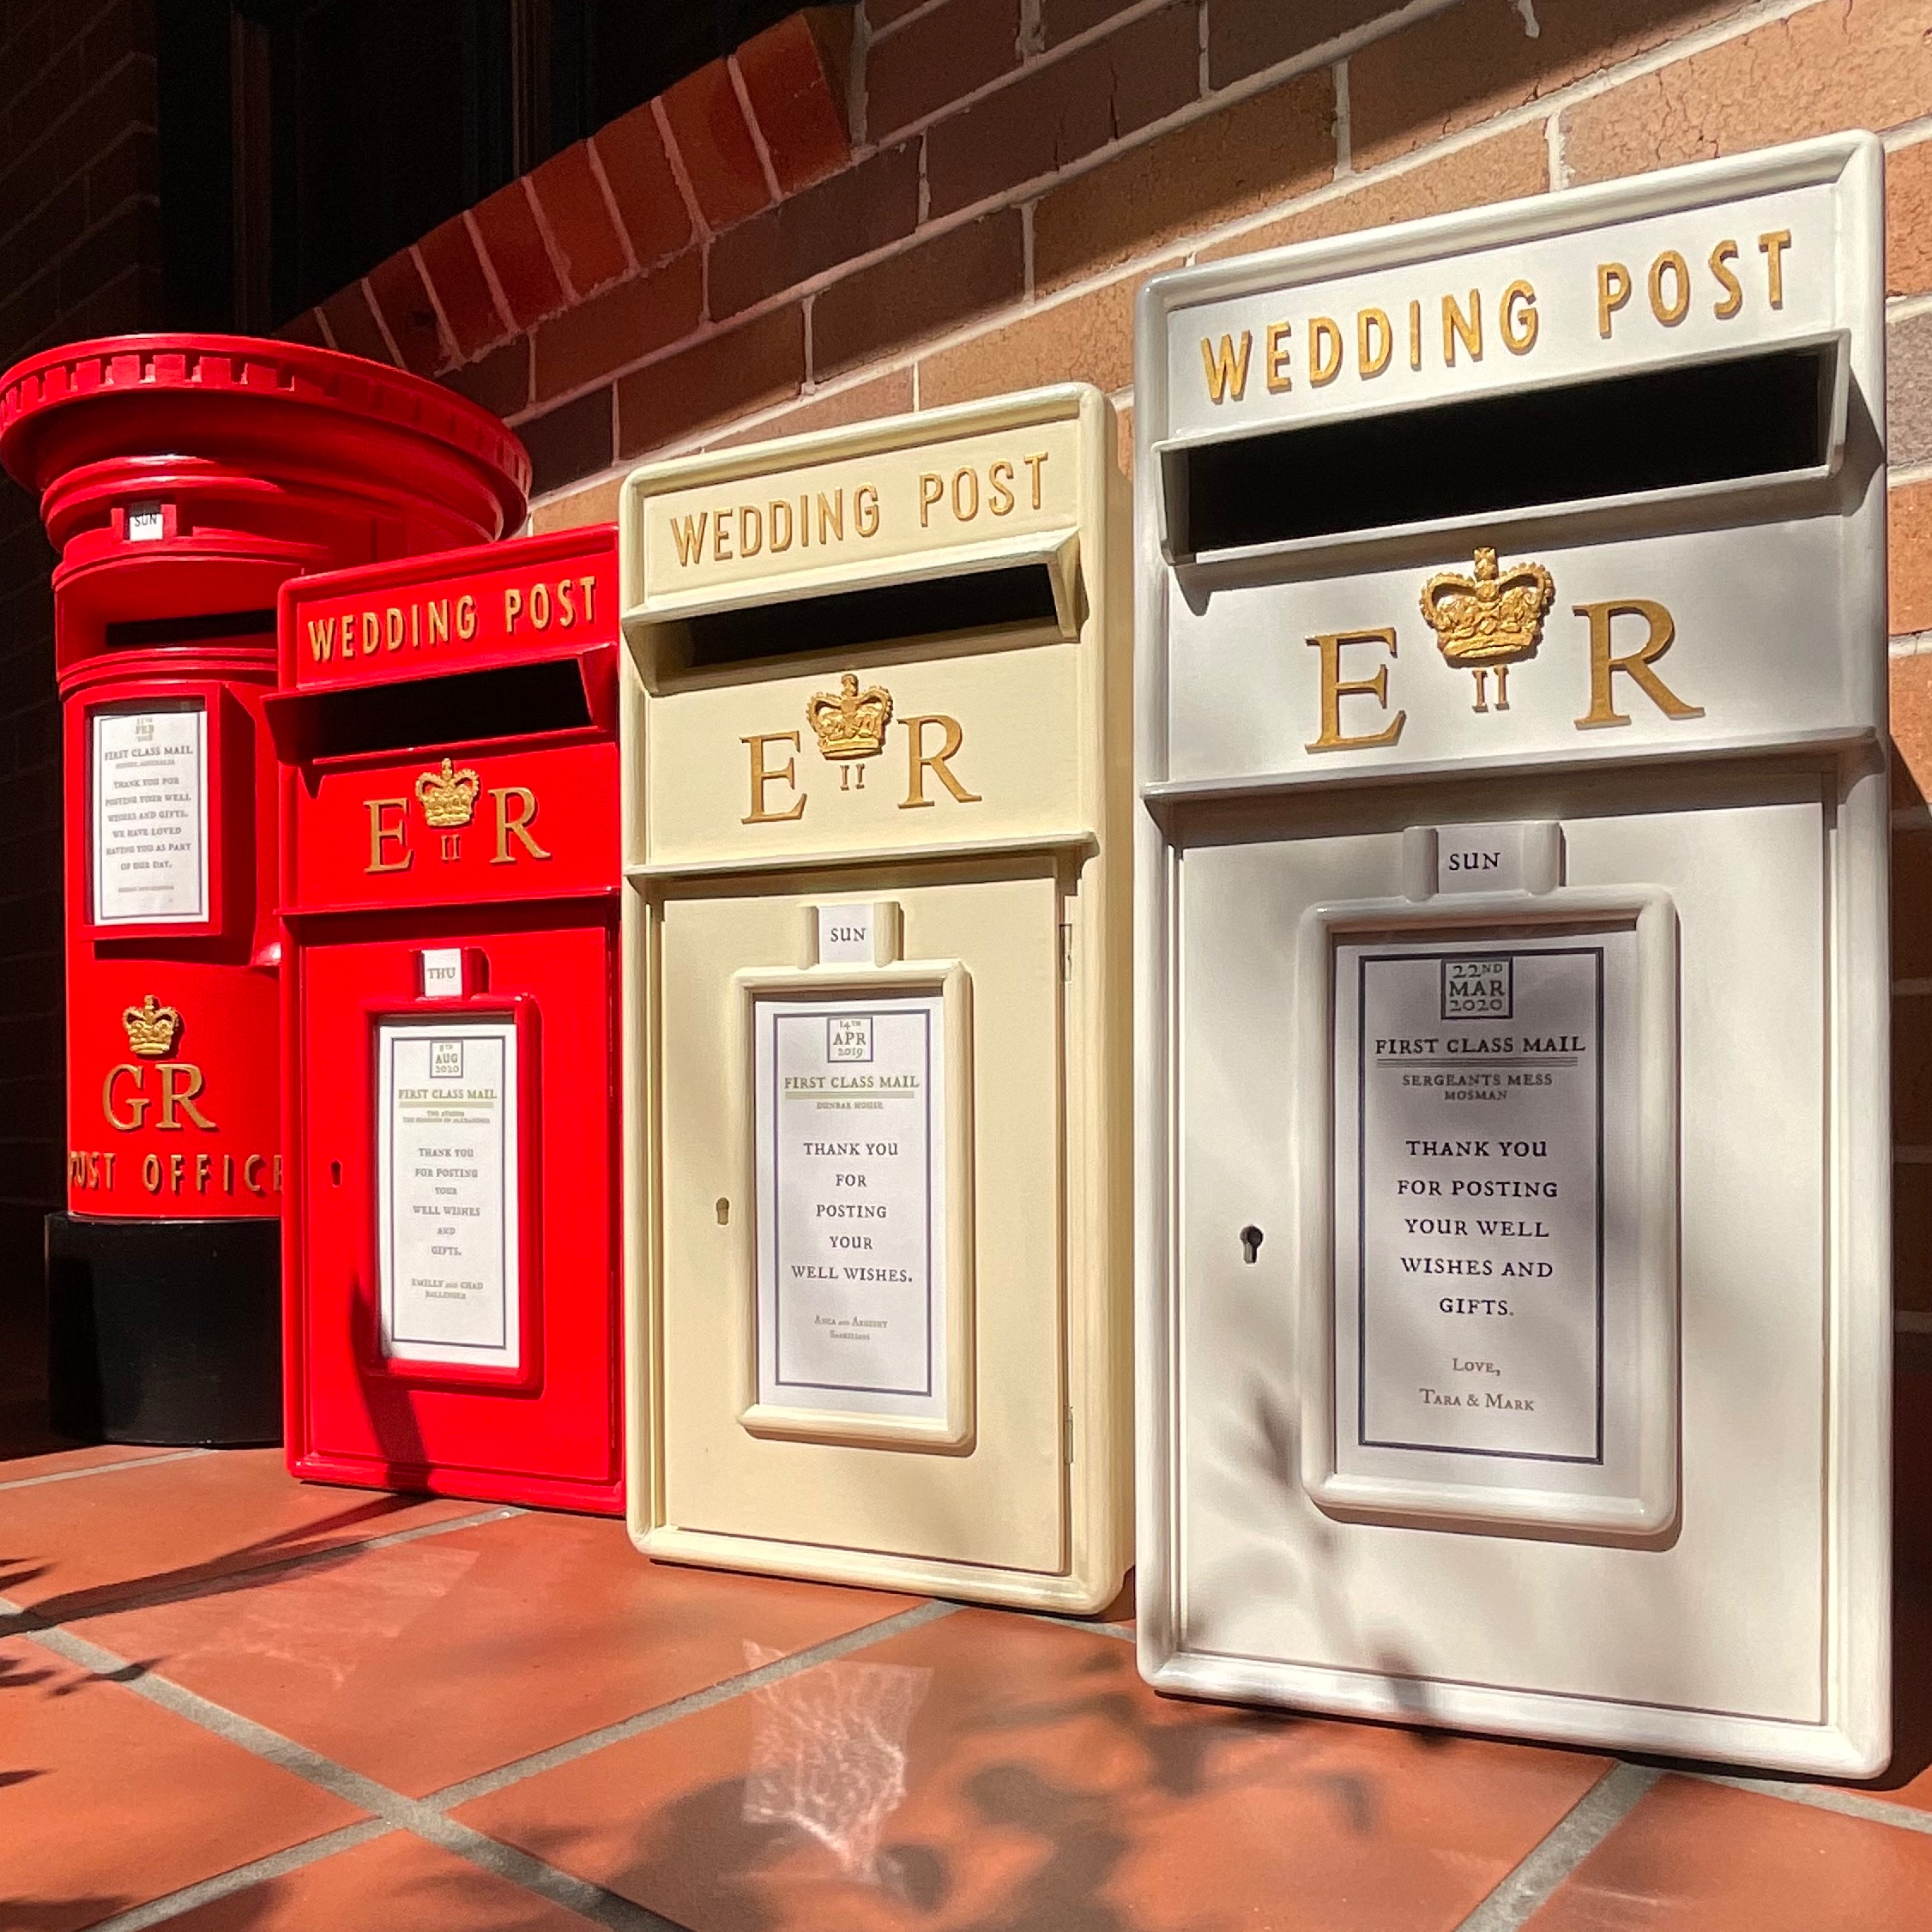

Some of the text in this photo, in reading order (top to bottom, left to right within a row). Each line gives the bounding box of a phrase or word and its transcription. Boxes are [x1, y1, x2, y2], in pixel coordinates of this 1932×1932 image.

[1200, 230, 1791, 403] WEDDING POST
[671, 451, 1048, 566] WEDDING POST
[135, 512, 157, 527] SUN
[307, 576, 595, 661] WEDDING POST
[1304, 627, 1407, 753] E
[1573, 599, 1705, 728] R
[105, 746, 193, 761] FIRST CLASS MAIL
[739, 730, 807, 824] E
[897, 714, 982, 810] R
[114, 779, 140, 788] THANK
[139, 811, 156, 819] AND
[127, 829, 148, 837] HAVE
[151, 827, 182, 836] LOVED
[363, 797, 414, 872] E
[488, 787, 552, 863] R
[1449, 852, 1500, 871] SUN
[830, 927, 866, 942] SUN
[427, 967, 456, 979] THU
[1452, 963, 1503, 979] 22ND
[1449, 981, 1506, 997] MAR
[1450, 999, 1503, 1012] 2020
[832, 1032, 866, 1046] APR
[1375, 1035, 1586, 1055] FIRST CLASS MAIL
[435, 1054, 458, 1065] AUG
[837, 1048, 864, 1059] 2019
[435, 1065, 460, 1073] 2020
[784, 1075, 920, 1089] FIRST CLASS MAIL
[1402, 1073, 1553, 1086] SERGEANTS MESS
[102, 1063, 216, 1130] GR
[398, 1089, 498, 1100] FIRST CLASS MAIL
[1445, 1090, 1507, 1101] MOSMAN
[419, 1148, 474, 1157] THANK YOU
[804, 1142, 898, 1156] THANK YOU
[1405, 1140, 1547, 1157] THANK YOU
[414, 1168, 478, 1178] FOR POSTING
[836, 1174, 867, 1187] FOR
[435, 1186, 457, 1195] YOUR
[1397, 1180, 1558, 1198] FOR POSTING
[413, 1205, 480, 1217] WELL WISHES
[816, 1204, 887, 1218] POSTING
[437, 1227, 456, 1235] AND
[1404, 1218, 1549, 1237] YOUR WELL
[830, 1235, 873, 1249] YOUR
[431, 1246, 462, 1256] GIFTS.
[791, 1265, 913, 1283] WELL WISHES.
[1400, 1258, 1554, 1277] WISHES AND
[460, 1281, 483, 1290] CHAD
[1440, 1298, 1514, 1316] GIFTS.
[1467, 1394, 1479, 1407] &
